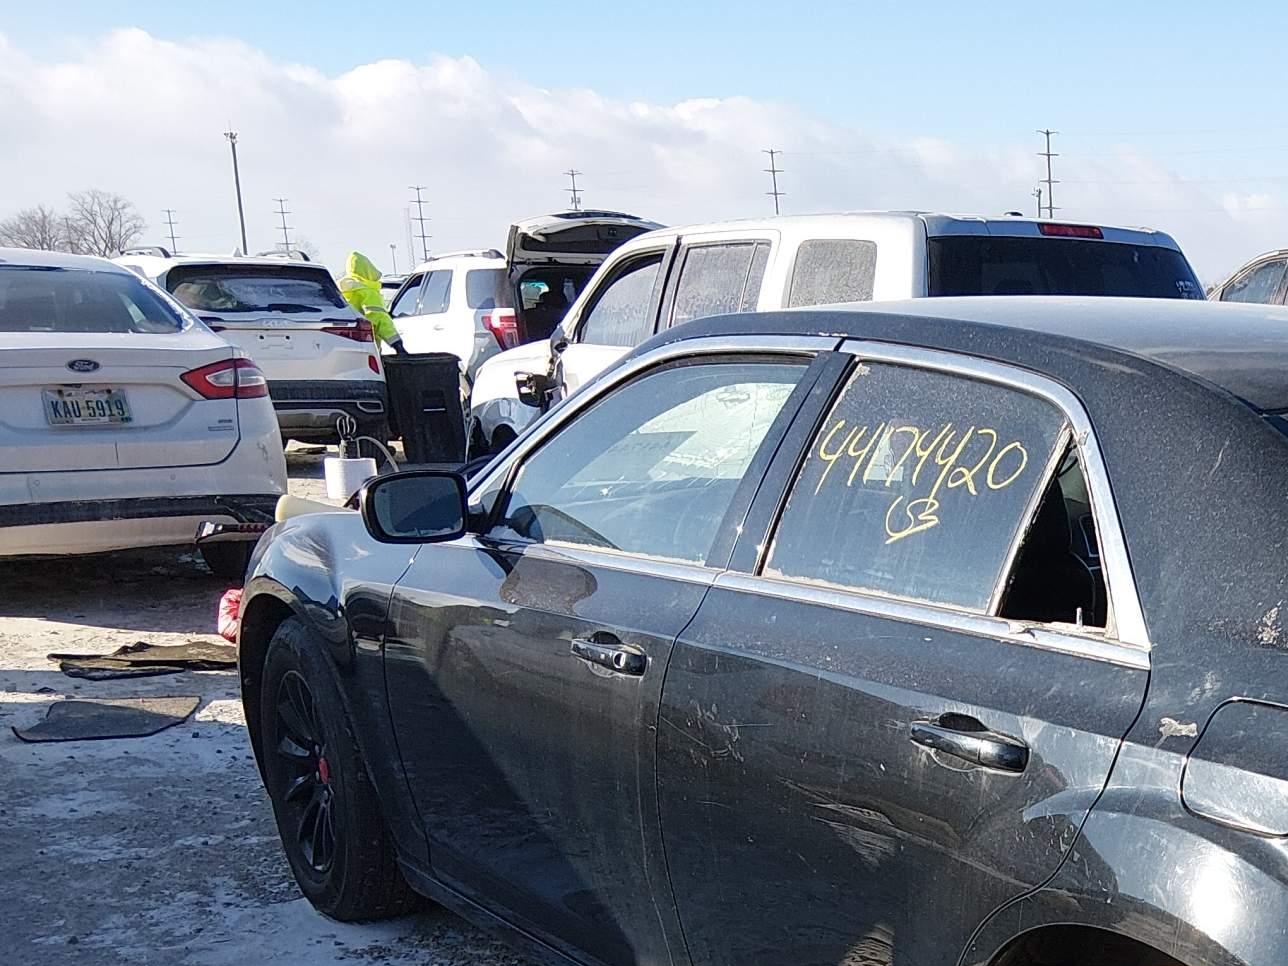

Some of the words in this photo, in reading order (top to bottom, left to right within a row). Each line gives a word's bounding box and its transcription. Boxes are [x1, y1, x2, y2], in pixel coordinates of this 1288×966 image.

[50, 399, 82, 418] KAU
[86, 399, 126, 418] 5919
[814, 419, 1028, 500] 44174420
